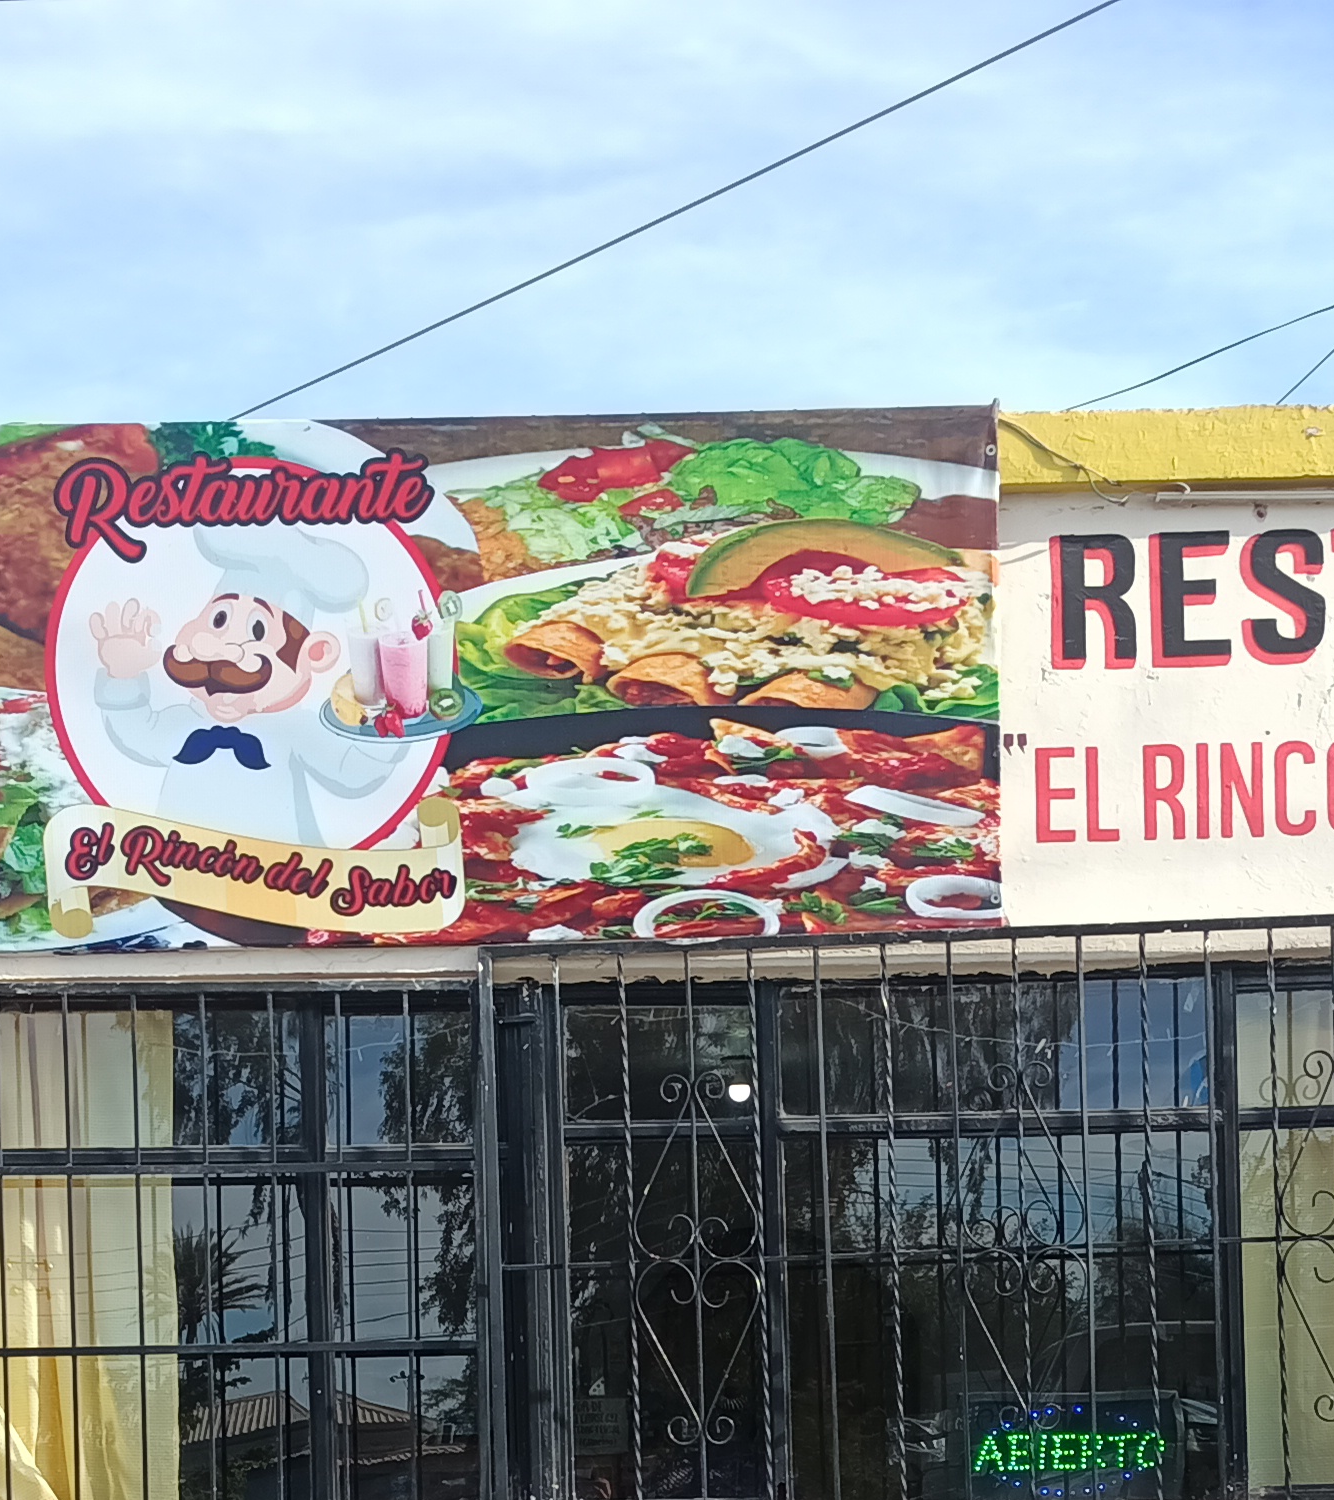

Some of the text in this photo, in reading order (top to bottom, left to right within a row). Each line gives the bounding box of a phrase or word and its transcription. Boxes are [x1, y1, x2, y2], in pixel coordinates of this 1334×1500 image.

[53, 451, 435, 563] Restaurante
[65, 822, 458, 916] El Rincón del Sabor
[973, 1431, 1166, 1472] ABIERTO
